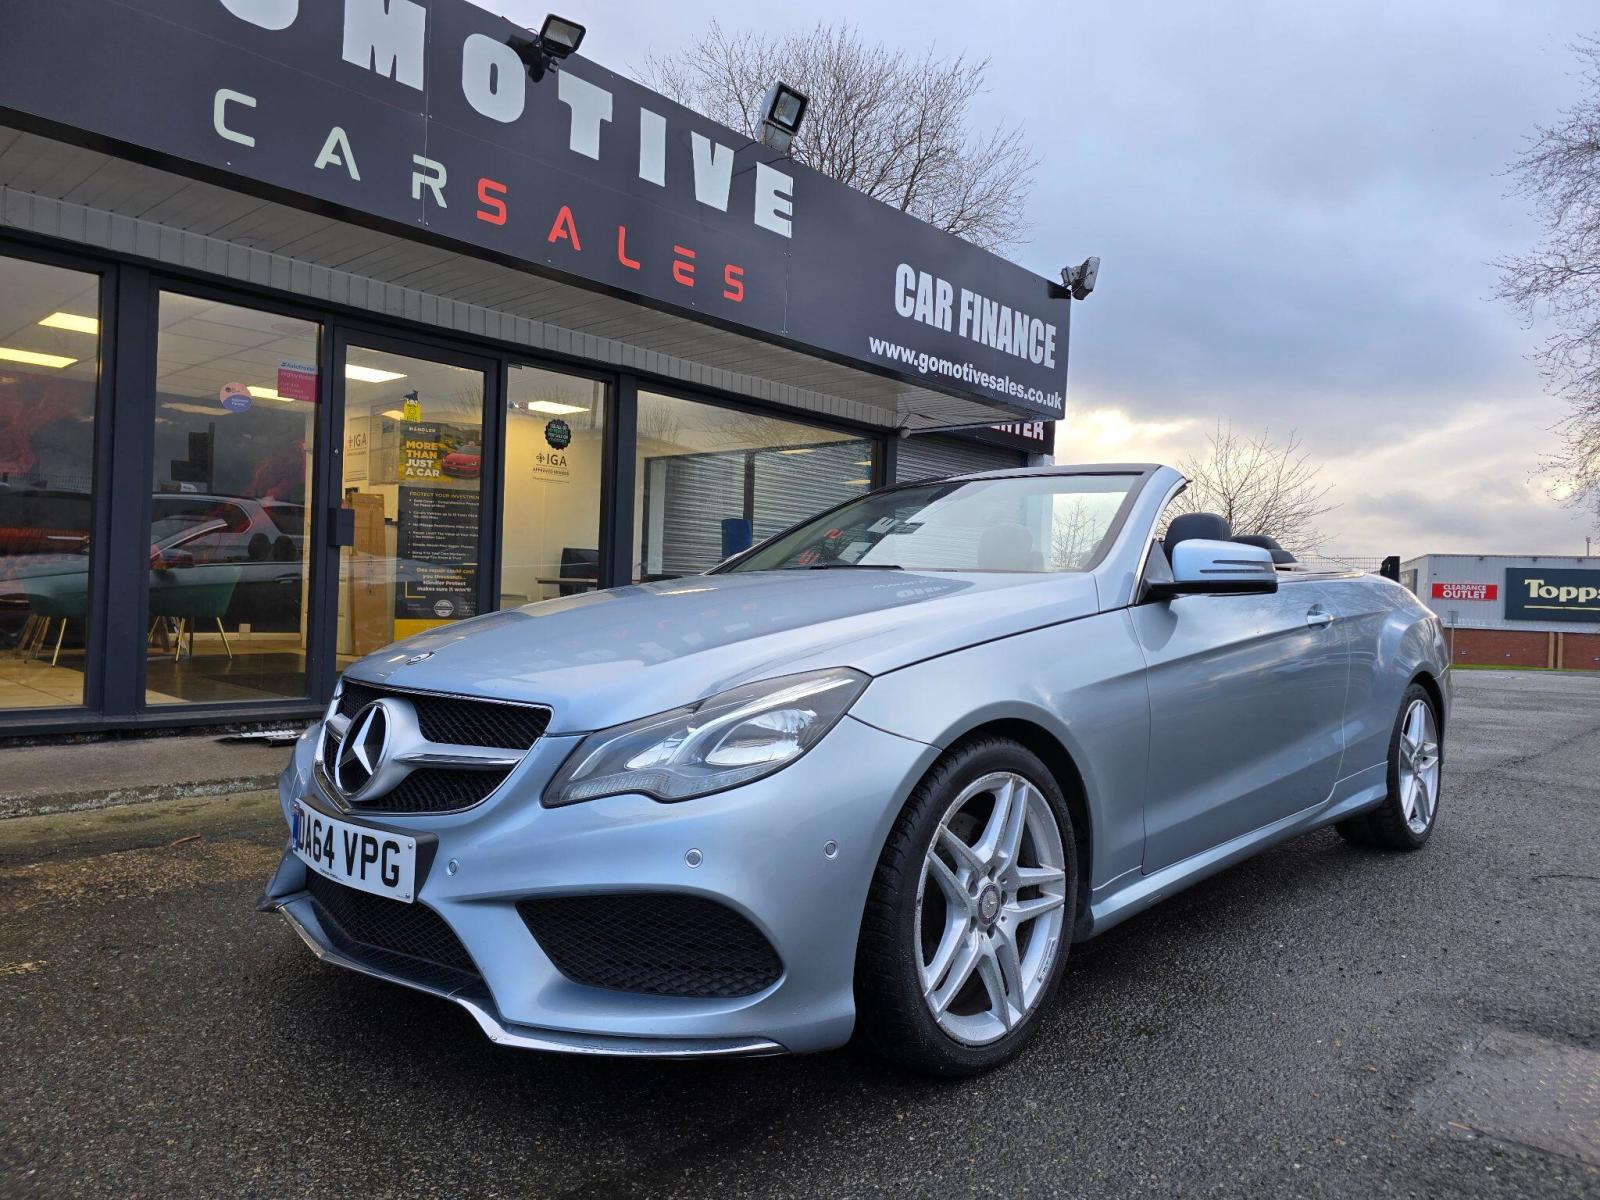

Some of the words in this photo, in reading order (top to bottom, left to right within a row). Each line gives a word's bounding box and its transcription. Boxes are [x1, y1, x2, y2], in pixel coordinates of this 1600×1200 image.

[894, 263, 954, 332] CAR
[958, 288, 1057, 370] FINANCE
[868, 336, 1062, 410] www.gomotivesales.co.uk
[353, 432, 367, 448] IGA
[406, 440, 438, 450] MORE
[406, 450, 438, 459] THAN
[546, 453, 567, 467] IGA
[405, 459, 434, 468] JUST
[405, 467, 414, 476] A
[416, 468, 440, 477] CAR
[1442, 590, 1487, 599] OUTLET
[1524, 579, 1600, 603] Topp
[298, 807, 335, 870] DA64
[343, 829, 401, 888] VPG
